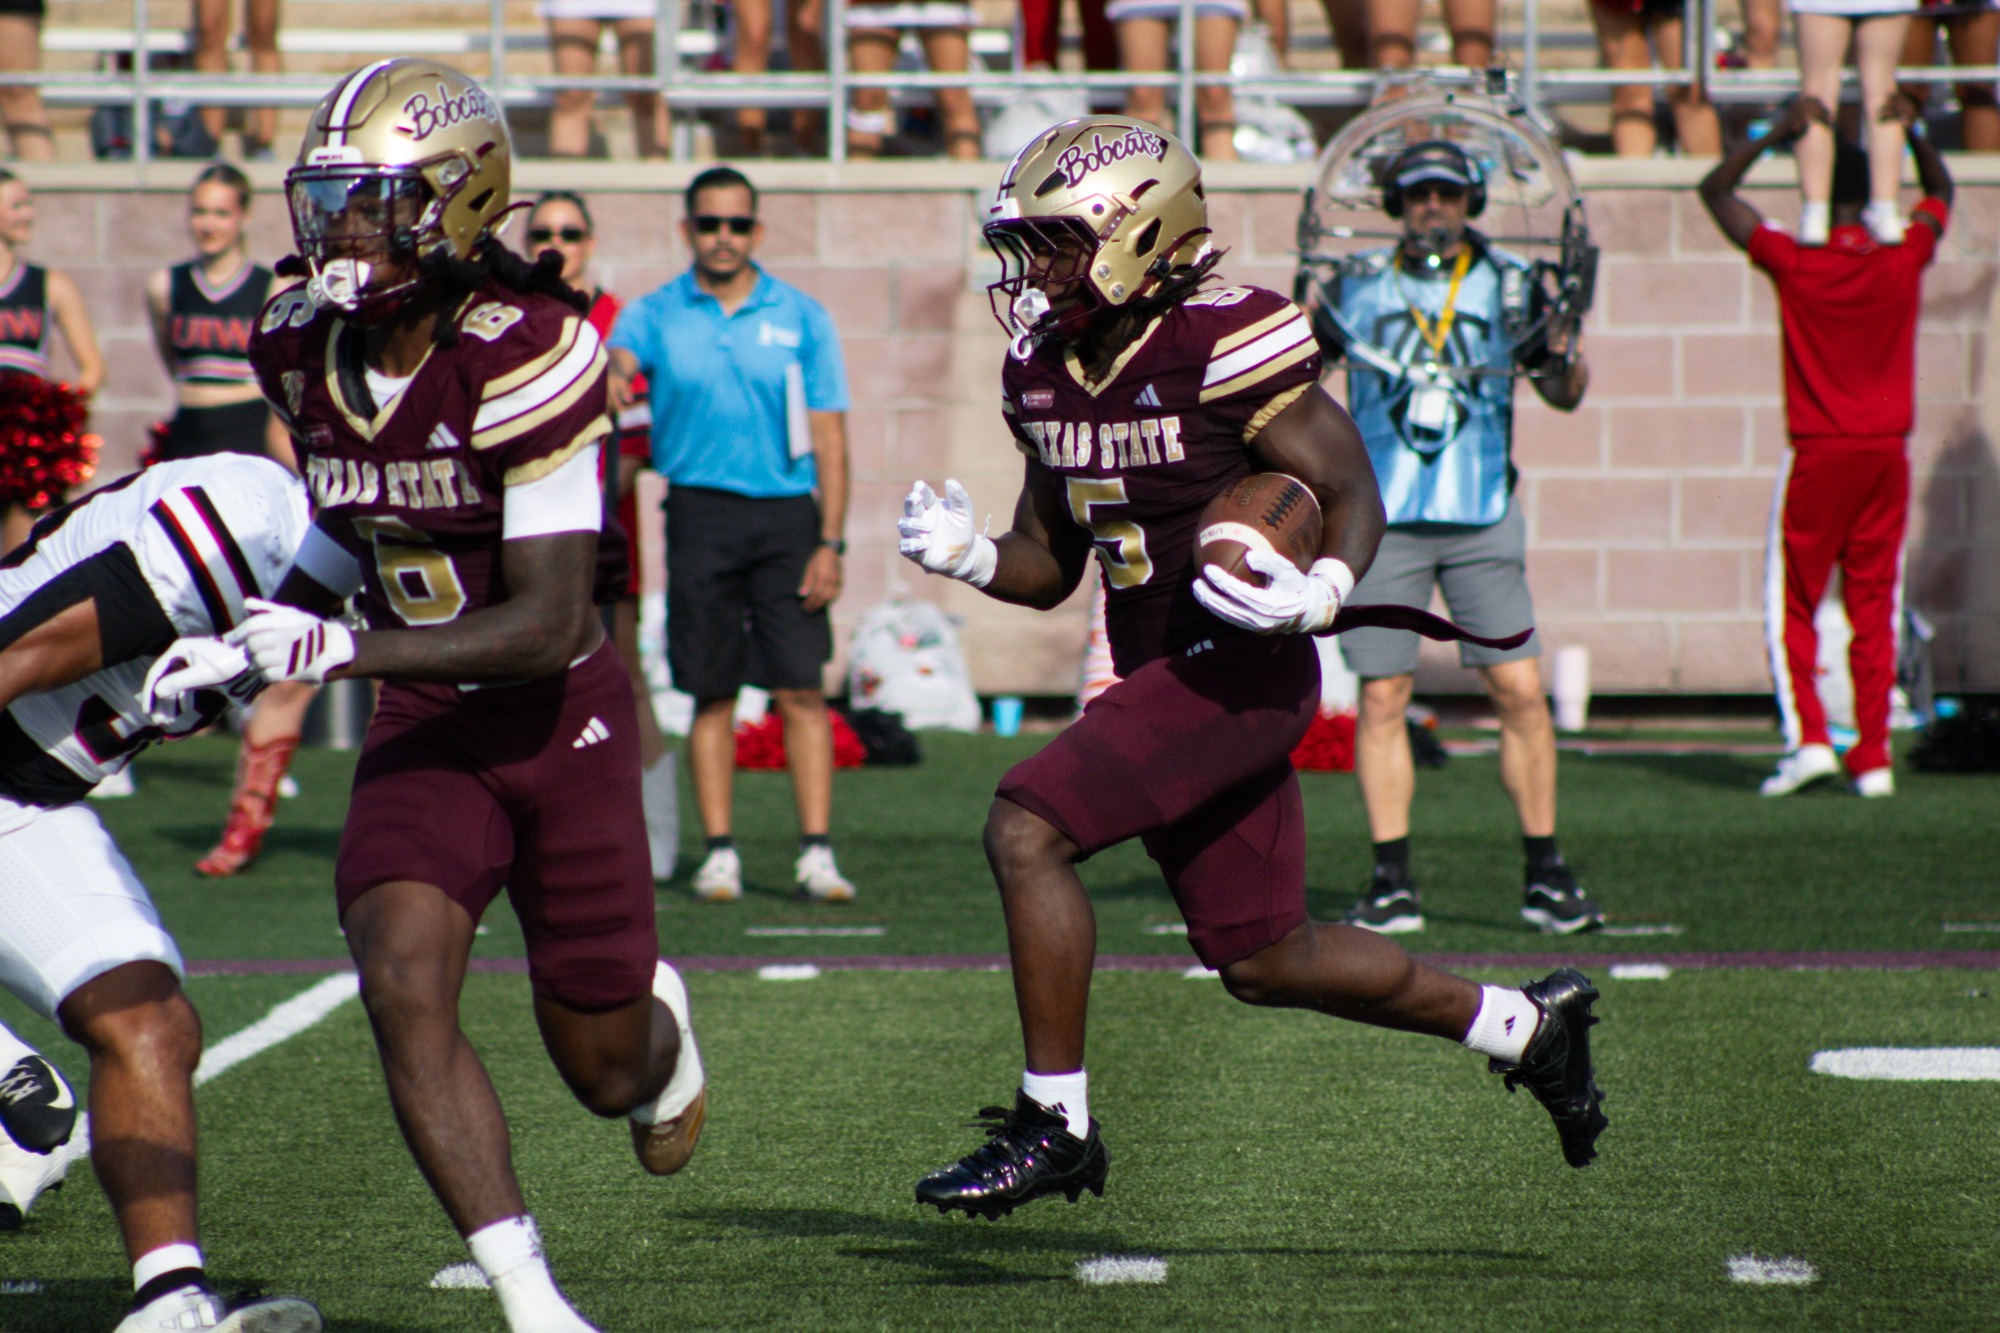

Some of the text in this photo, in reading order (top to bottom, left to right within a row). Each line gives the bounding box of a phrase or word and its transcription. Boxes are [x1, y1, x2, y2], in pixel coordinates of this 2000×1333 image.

[1056, 126, 1161, 190] Bobcats
[461, 301, 525, 342] 6
[1098, 416, 1186, 469] STATE
[1065, 476, 1154, 590] 5
[351, 514, 468, 627] 6
